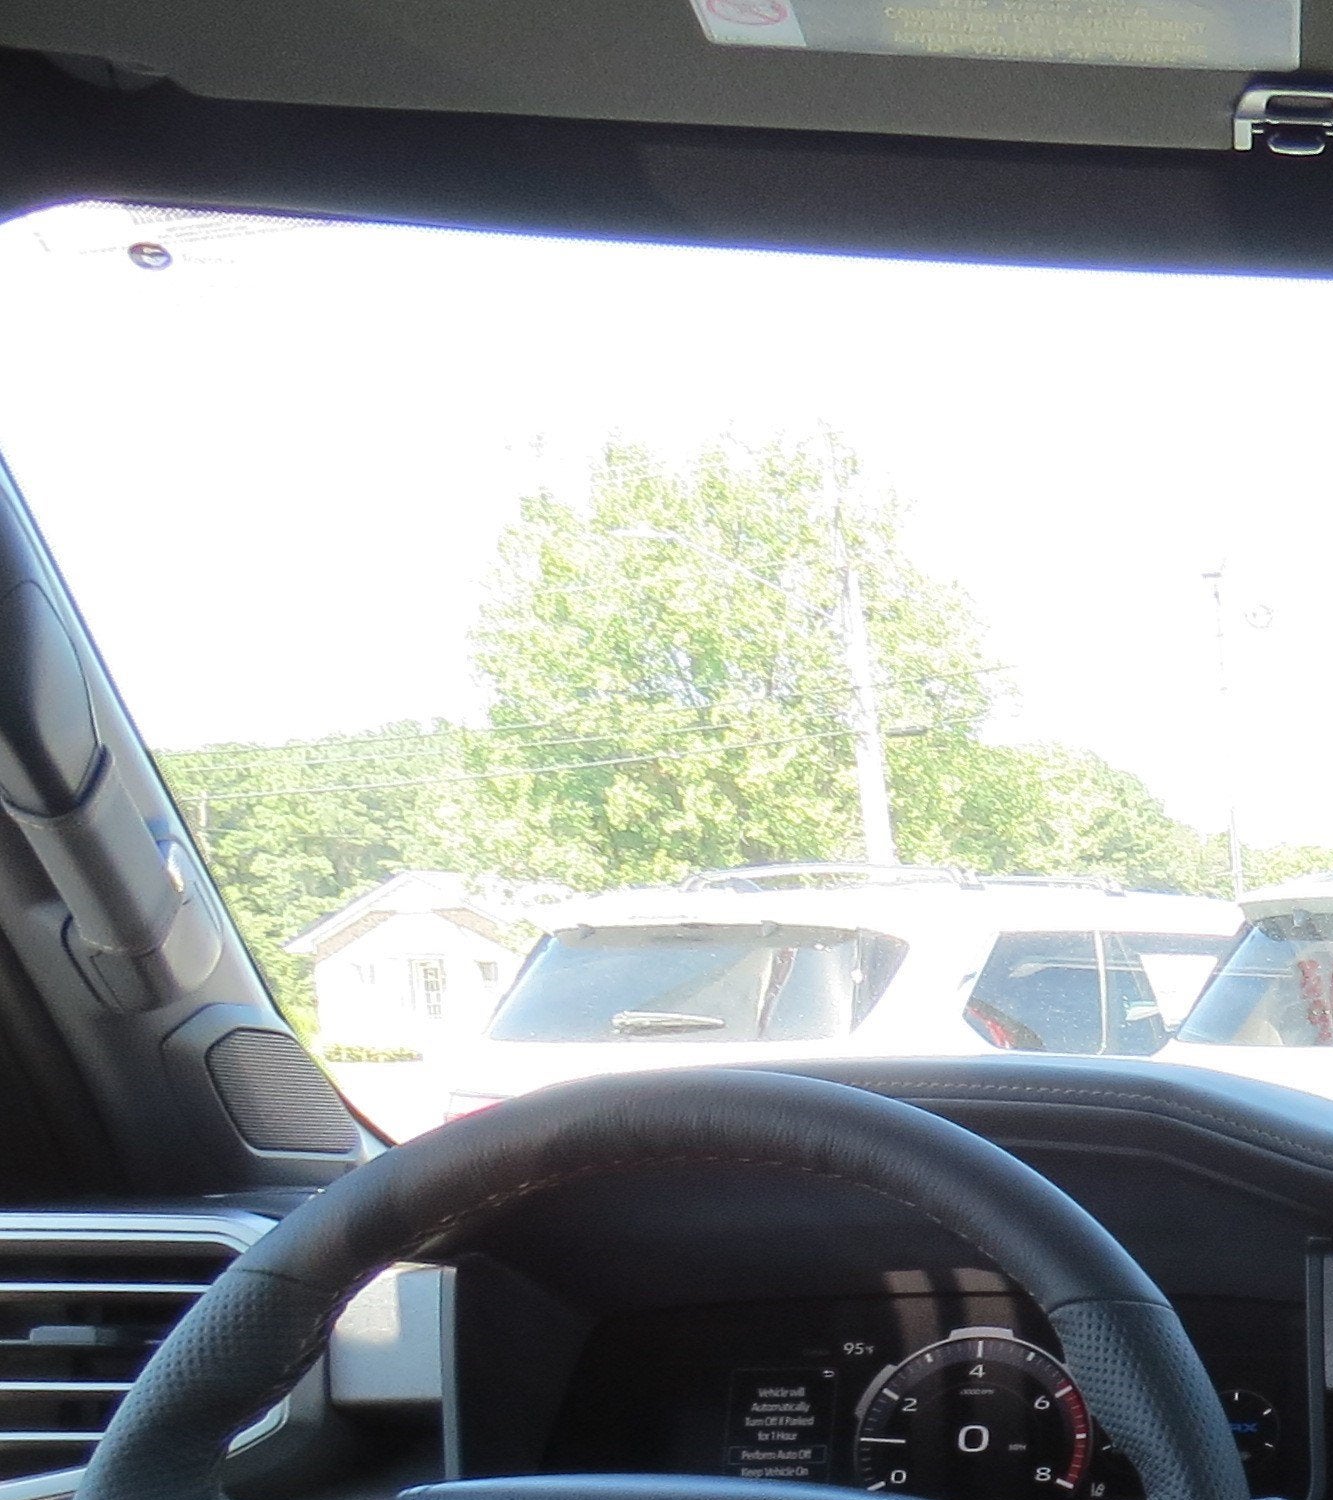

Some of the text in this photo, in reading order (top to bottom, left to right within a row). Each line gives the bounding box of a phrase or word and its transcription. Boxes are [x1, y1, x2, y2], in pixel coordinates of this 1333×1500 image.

[968, 1364, 986, 1379] 4
[902, 1398, 918, 1413] 2
[1033, 1396, 1051, 1410] 6
[958, 1424, 990, 1453] 0
[890, 1469, 907, 1484] 0
[1034, 1467, 1052, 1482] 8
